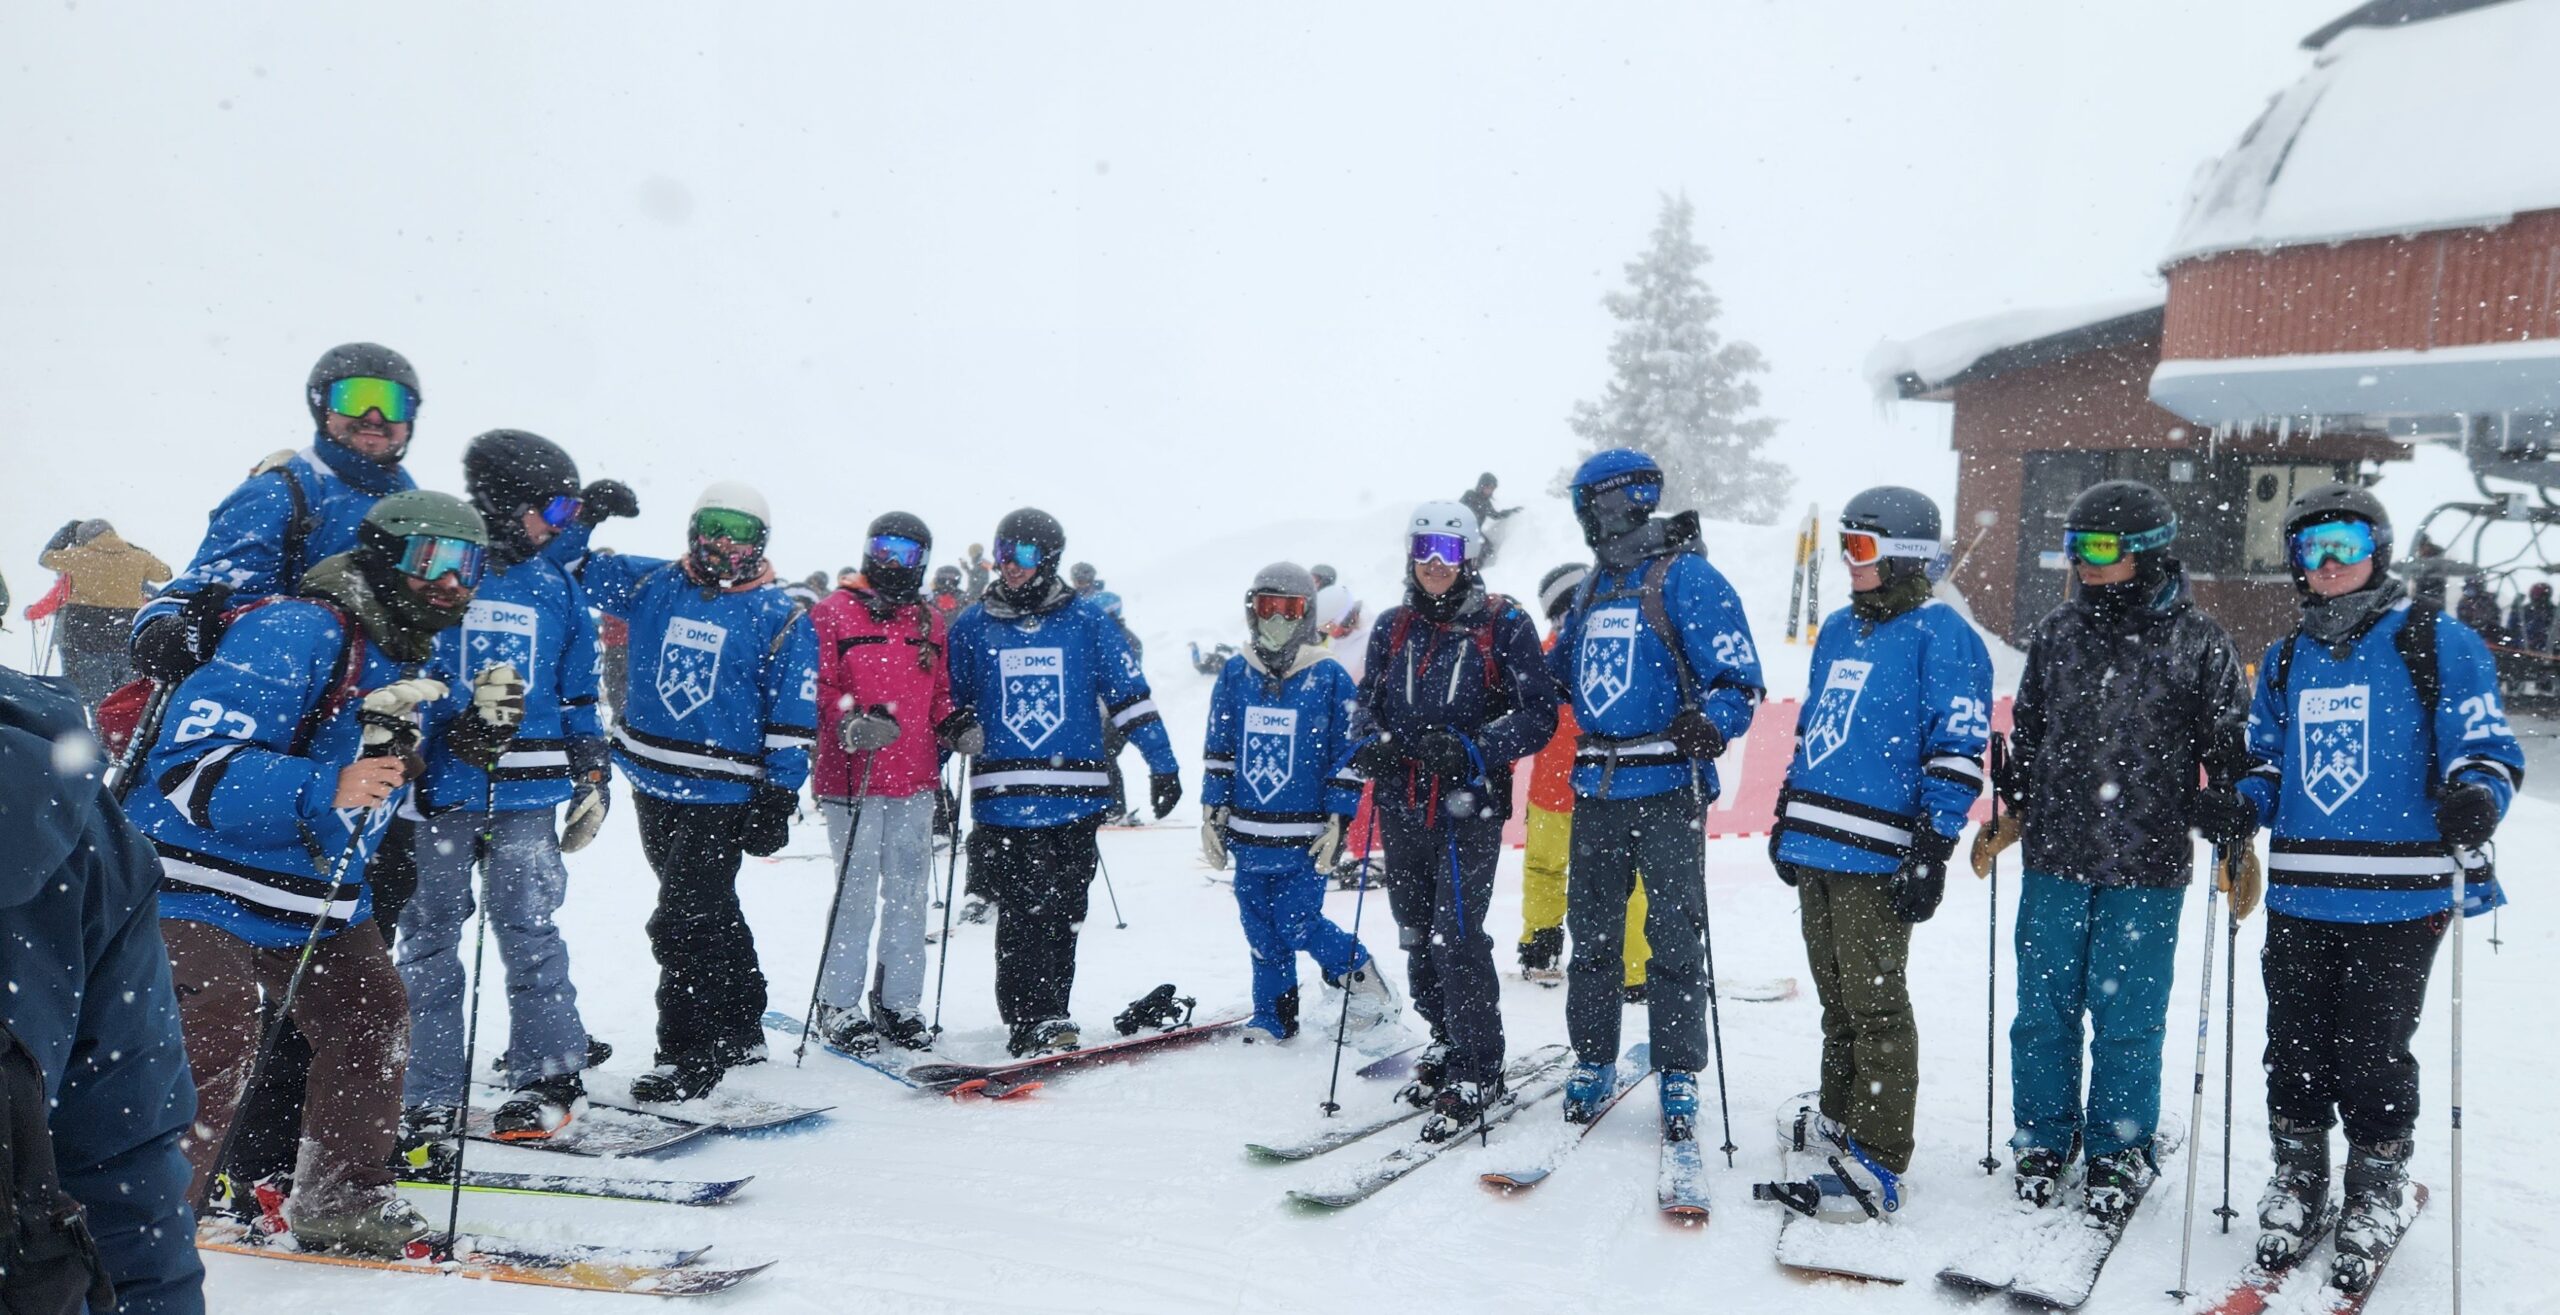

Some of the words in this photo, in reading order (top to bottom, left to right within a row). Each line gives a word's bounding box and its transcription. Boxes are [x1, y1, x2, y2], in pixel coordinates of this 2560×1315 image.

[492, 610, 529, 626] DMC
[1602, 617, 1630, 629] DMC
[686, 628, 718, 644] DMC
[1712, 630, 1754, 666] 23
[1024, 656, 1056, 667] DMC
[1838, 668, 1863, 681] DMC
[1263, 715, 1290, 727] DMC
[1945, 696, 1990, 738] 25
[121, 725, 145, 769] LEKI
[331, 847, 354, 888] LEKI
